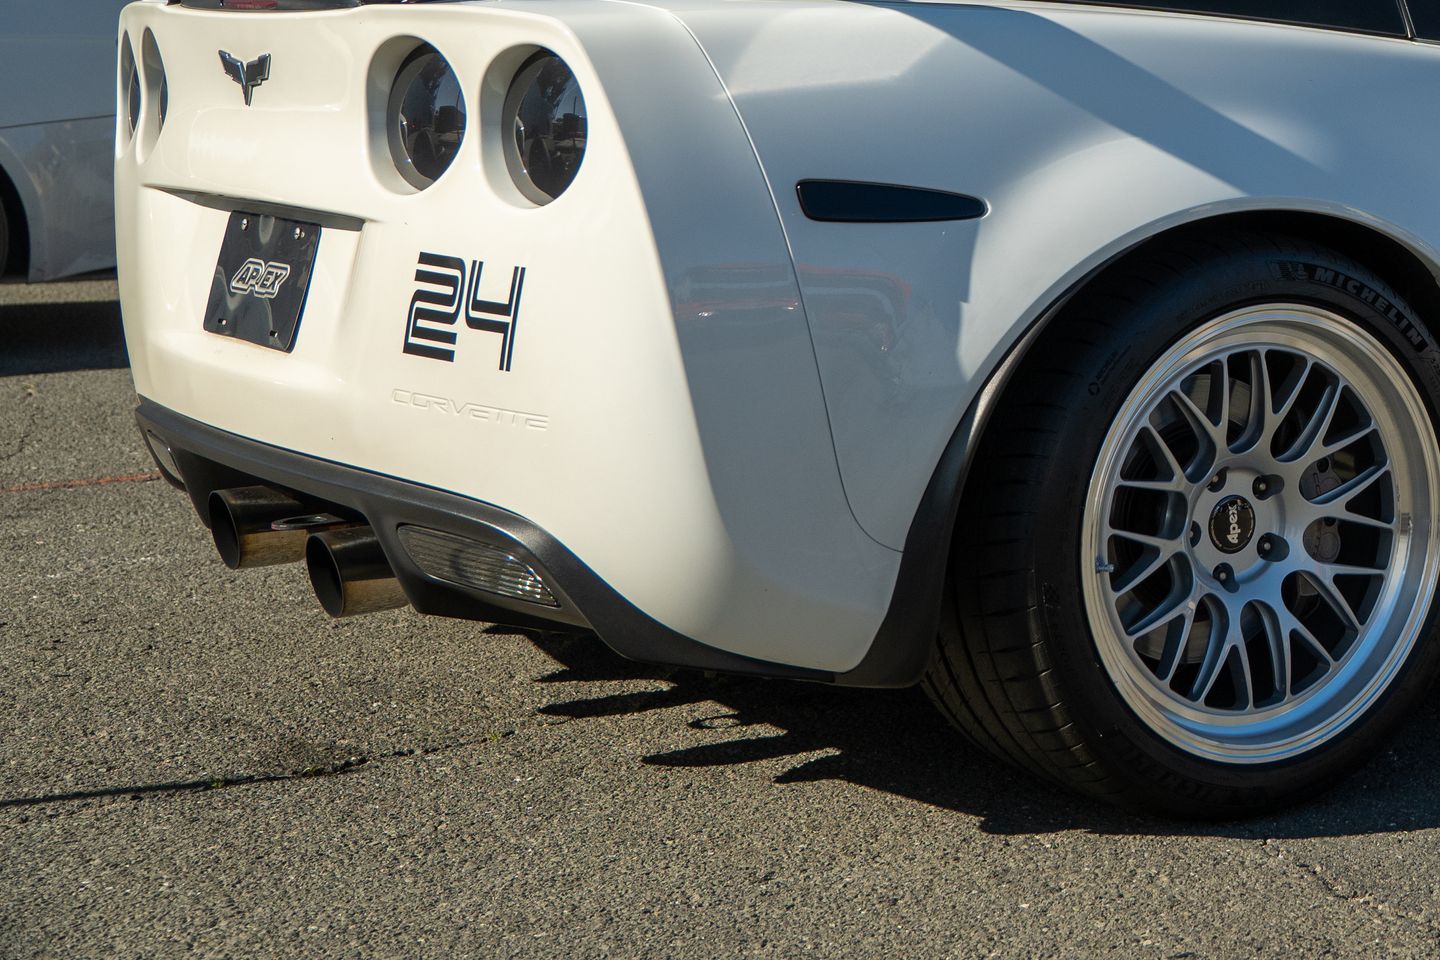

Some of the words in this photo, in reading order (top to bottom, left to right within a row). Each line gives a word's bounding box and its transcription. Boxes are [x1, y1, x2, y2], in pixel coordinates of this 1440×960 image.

[403, 251, 526, 371] 24
[1314, 266, 1425, 348] MICHELIN
[392, 388, 549, 430] CORVETTE
[1227, 504, 1240, 543] Apex
